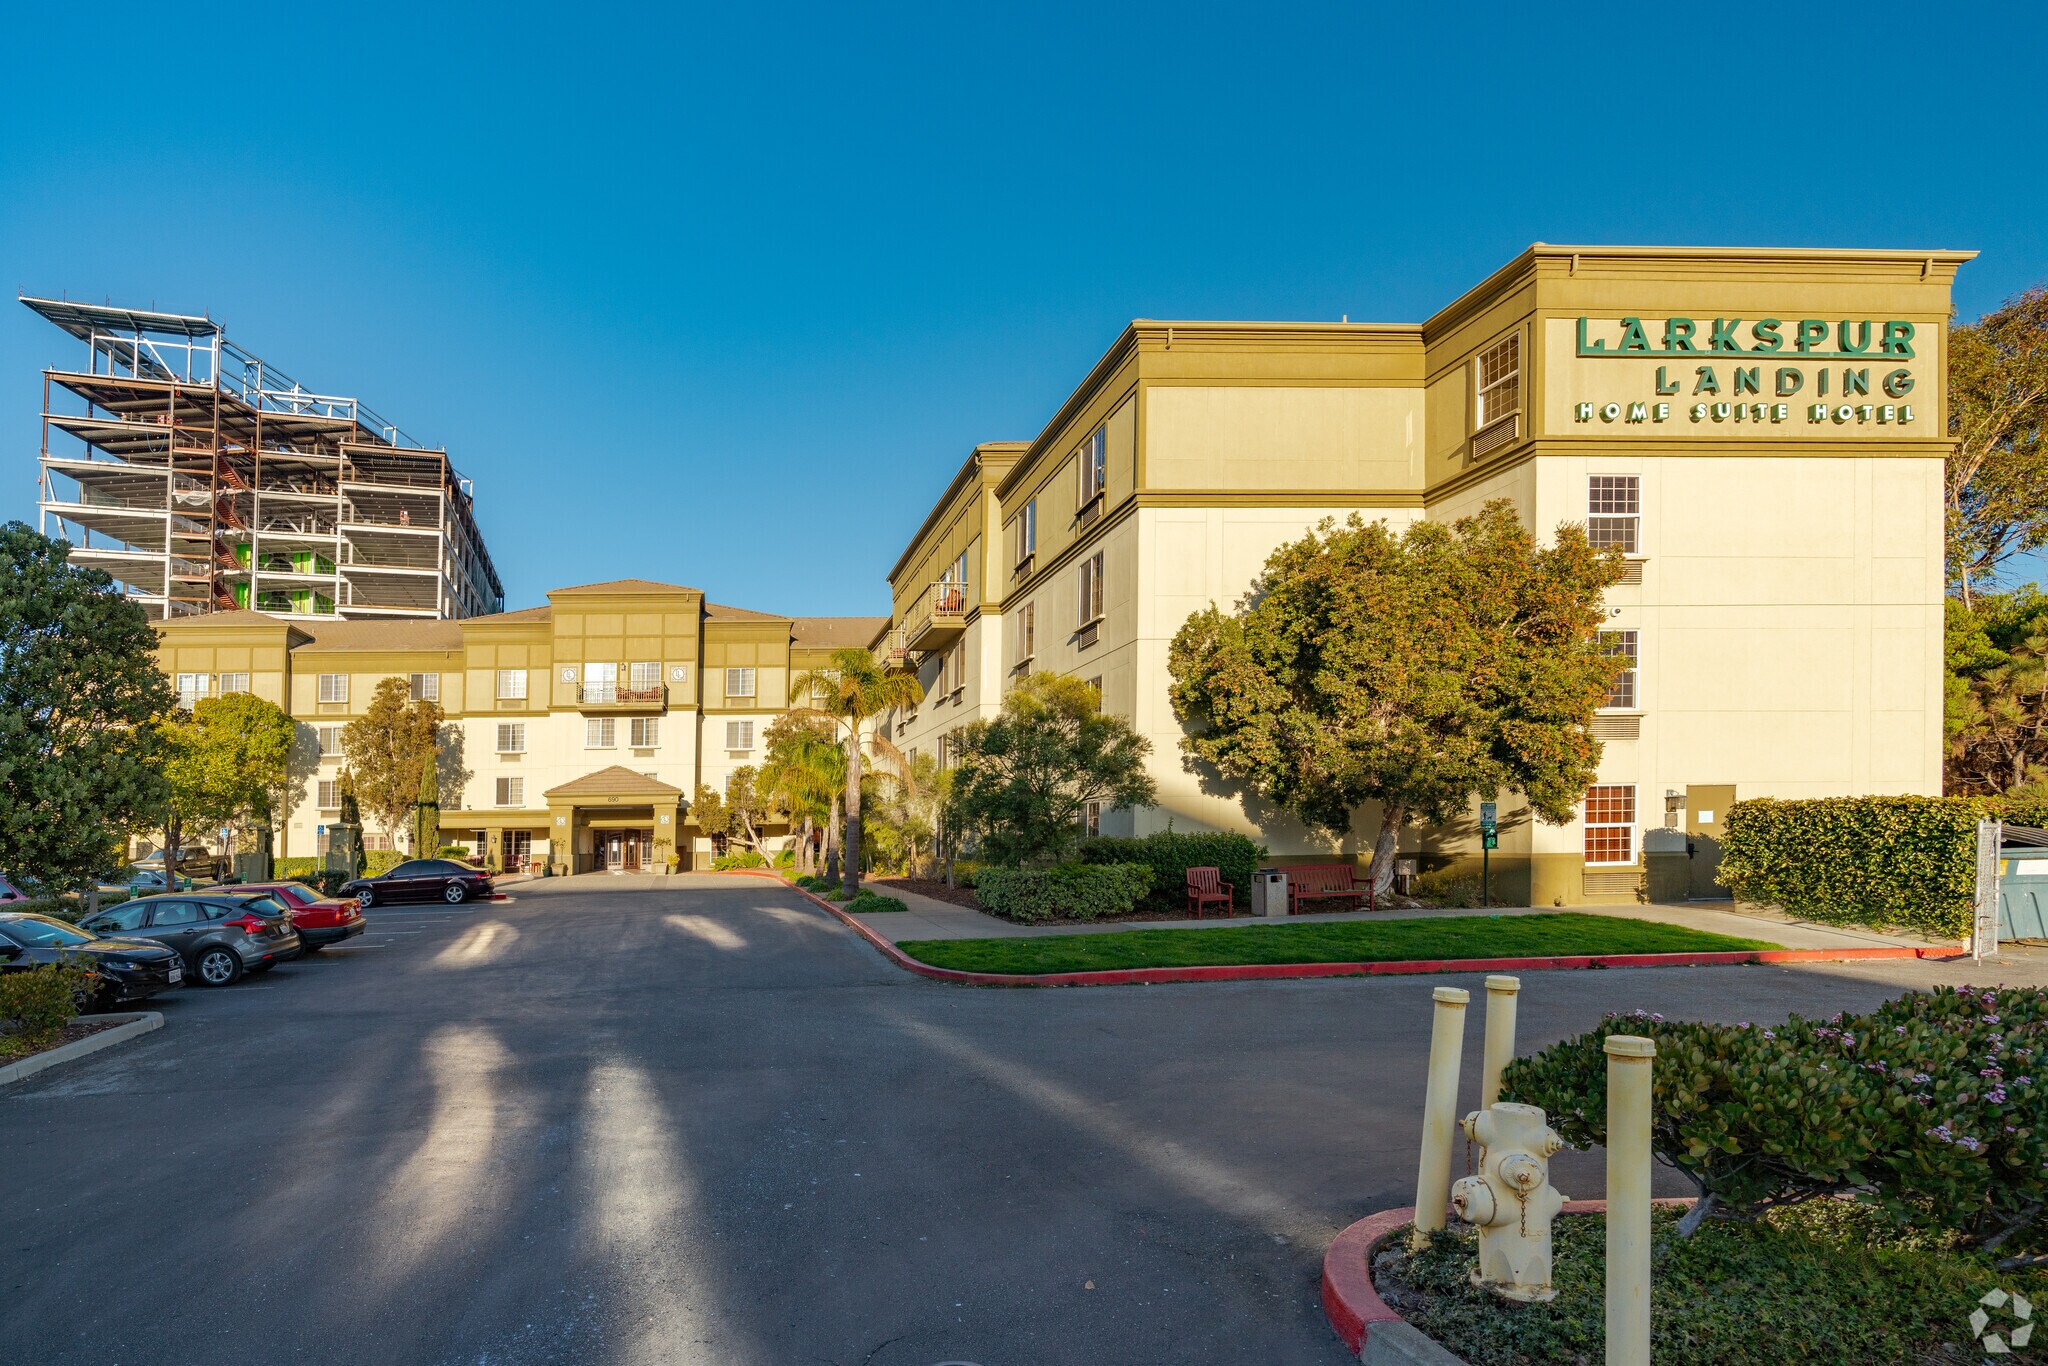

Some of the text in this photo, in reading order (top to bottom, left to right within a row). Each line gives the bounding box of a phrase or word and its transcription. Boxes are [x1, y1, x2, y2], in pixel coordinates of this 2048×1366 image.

[1576, 316, 1916, 359] LARKSPUR
[1656, 366, 1916, 397] LANDING
[1575, 402, 1914, 424] HOME SUITE HOTEL
